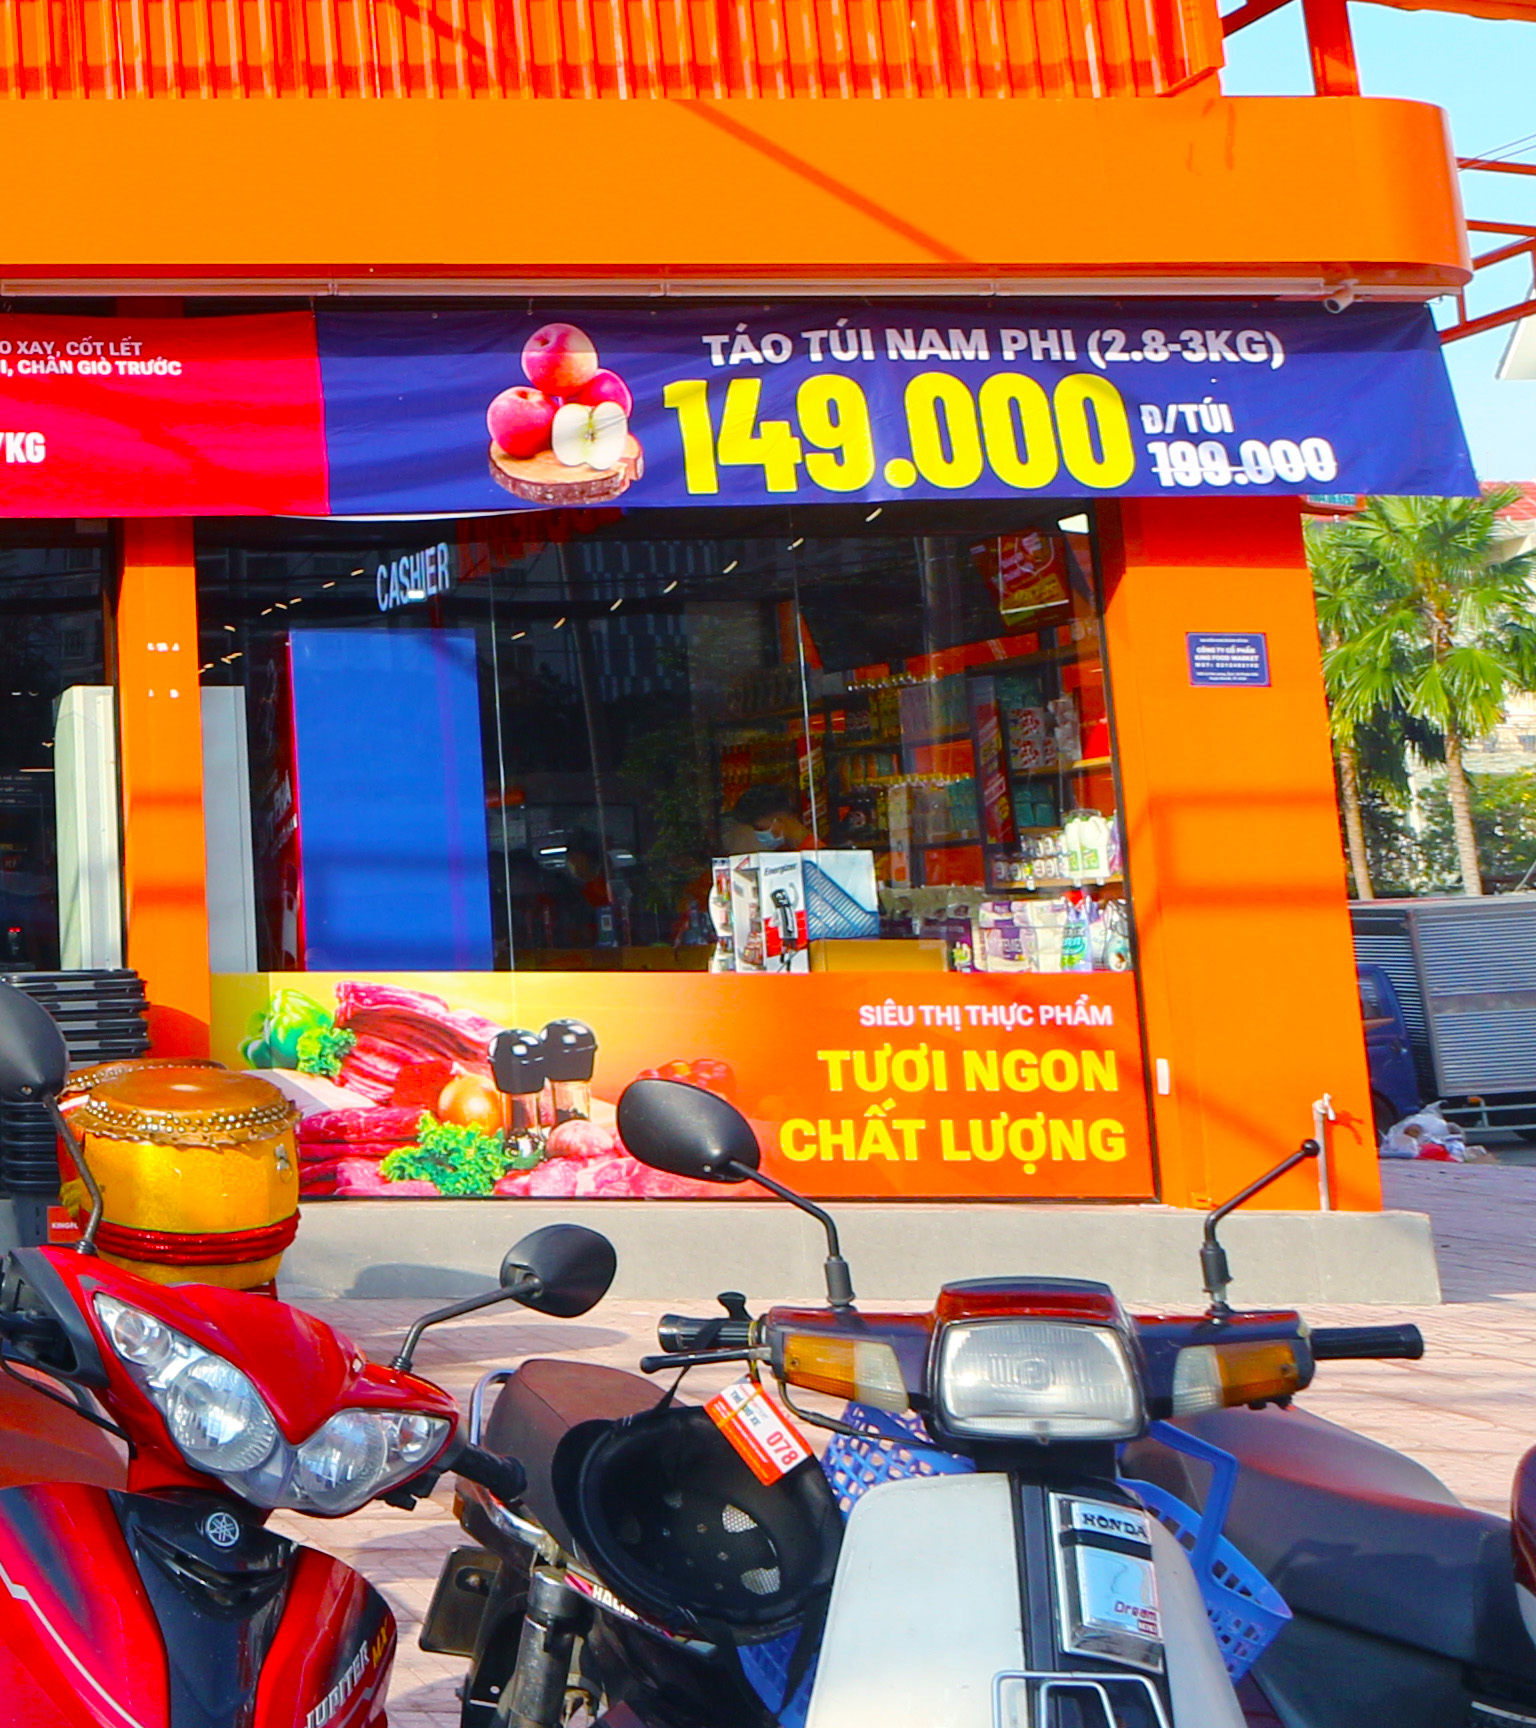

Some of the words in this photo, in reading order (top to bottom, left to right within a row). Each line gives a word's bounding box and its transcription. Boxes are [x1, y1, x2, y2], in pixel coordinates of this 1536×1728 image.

[17, 341, 61, 358] XAY,
[66, 336, 104, 356] CỐT
[109, 336, 143, 356] LẾT
[17, 355, 74, 375] CHÂN
[77, 356, 112, 375] GIÒ
[115, 356, 183, 376] TRƯỚC
[702, 323, 792, 367] TÁO
[801, 318, 875, 363] TÚI
[886, 329, 990, 362] NAM
[1001, 329, 1077, 362] PHI
[1087, 328, 1286, 371] (2.8-3KG)
[662, 371, 1135, 495] 149.000
[1139, 397, 1236, 434] Đ/TÚI
[1146, 437, 1339, 487] 199.000
[376, 542, 450, 611] CASHIER
[859, 998, 915, 1028] SIÊU
[918, 1004, 963, 1032] THỊ
[964, 1002, 1035, 1032] THỰC
[1038, 993, 1115, 1027] PHẨM
[817, 1042, 948, 1094] TƯƠI
[963, 1048, 1120, 1094] NGON
[778, 1094, 927, 1164] CHẤT
[940, 1110, 1128, 1176] LƯỢNG
[766, 1430, 800, 1466] 078
[1081, 1512, 1148, 1539] HONDA
[592, 1584, 640, 1621] HALI
[1113, 1601, 1158, 1622] Dream
[303, 1640, 371, 1728] JUPITER
